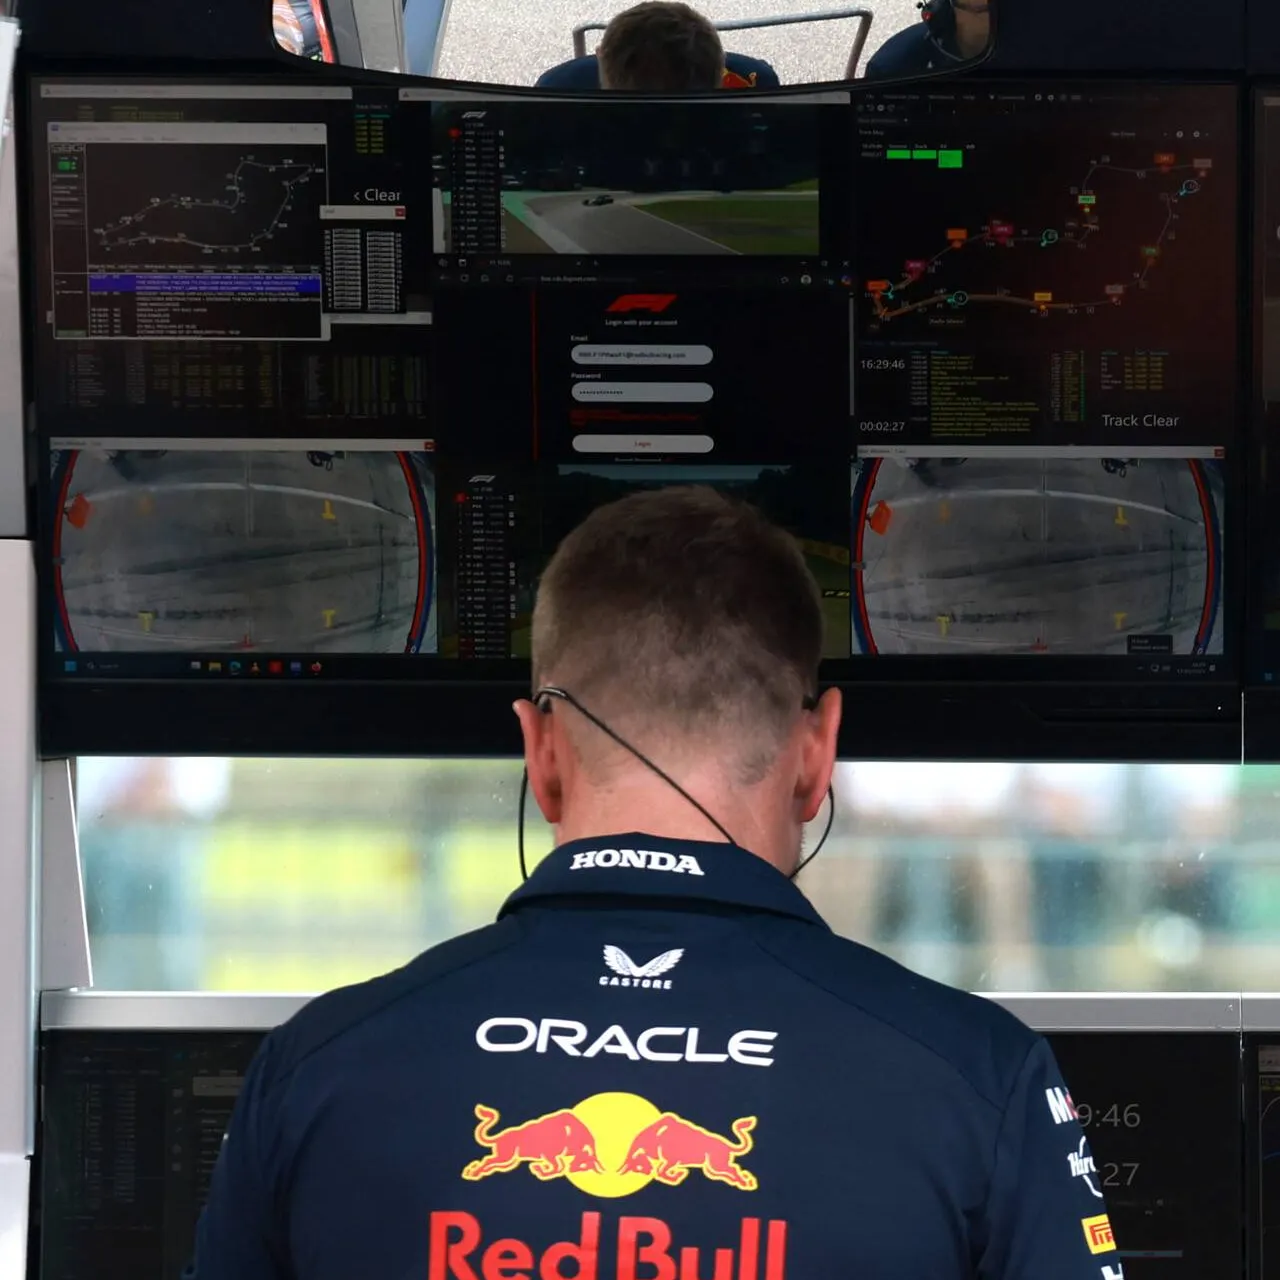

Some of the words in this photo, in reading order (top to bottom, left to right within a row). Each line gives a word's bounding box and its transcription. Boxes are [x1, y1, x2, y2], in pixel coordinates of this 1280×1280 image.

[364, 188, 401, 201] Clear
[860, 359, 906, 370] 16:29:46
[860, 421, 906, 432] 00:02:27
[1101, 414, 1139, 427] Track
[1143, 414, 1180, 427] Clear
[570, 849, 705, 876] HONDA
[599, 976, 673, 990] CASTORE
[475, 1016, 779, 1067] ORACLE
